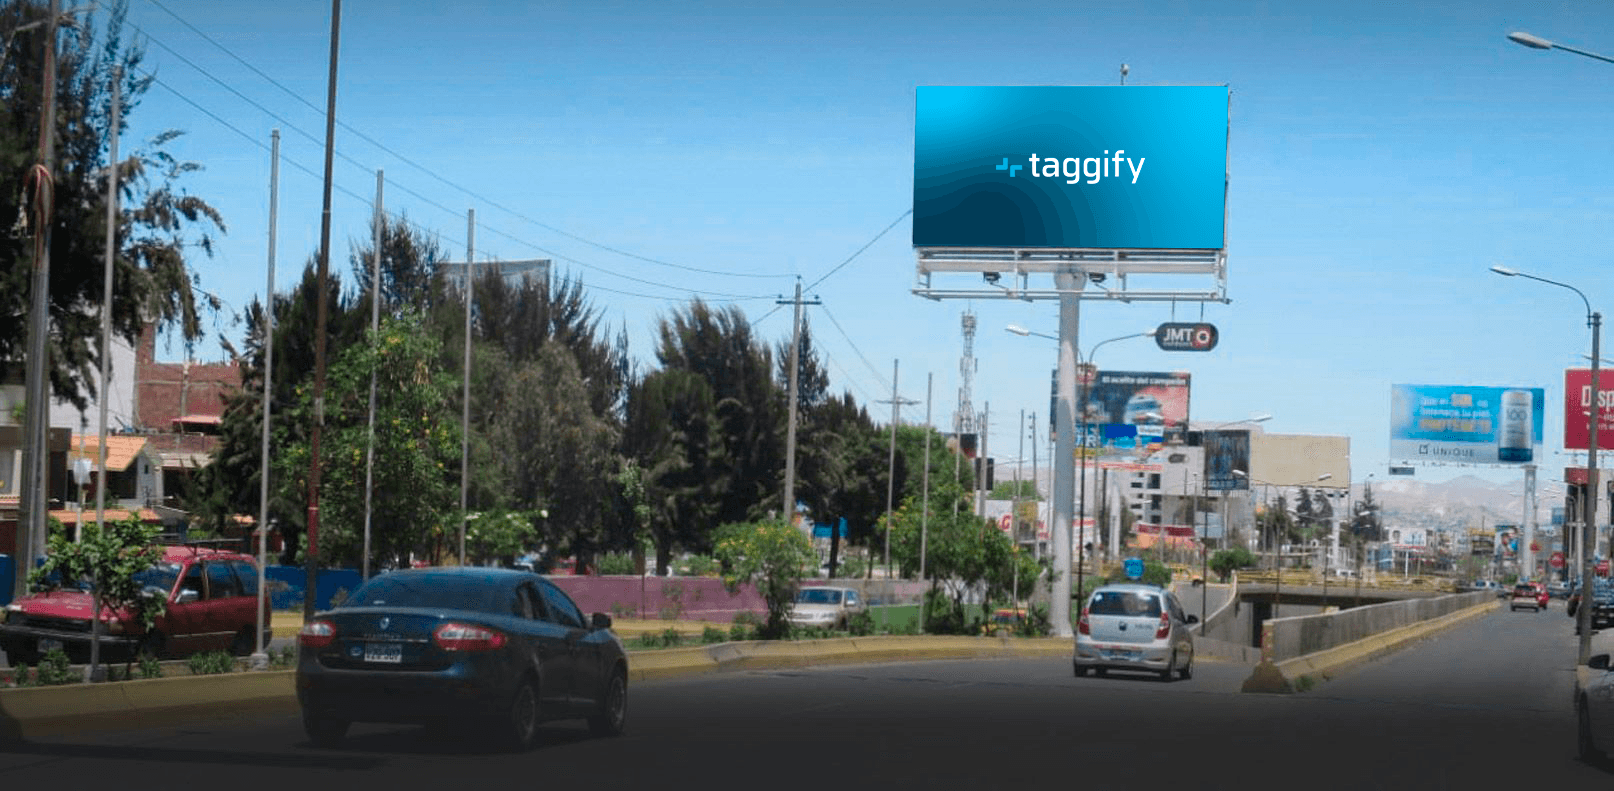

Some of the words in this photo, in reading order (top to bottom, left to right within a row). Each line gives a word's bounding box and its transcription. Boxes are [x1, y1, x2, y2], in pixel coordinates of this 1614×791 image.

[1028, 149, 1146, 184] taggify
[1163, 328, 1195, 342] JMT
[1432, 446, 1474, 458] UNIQUE
